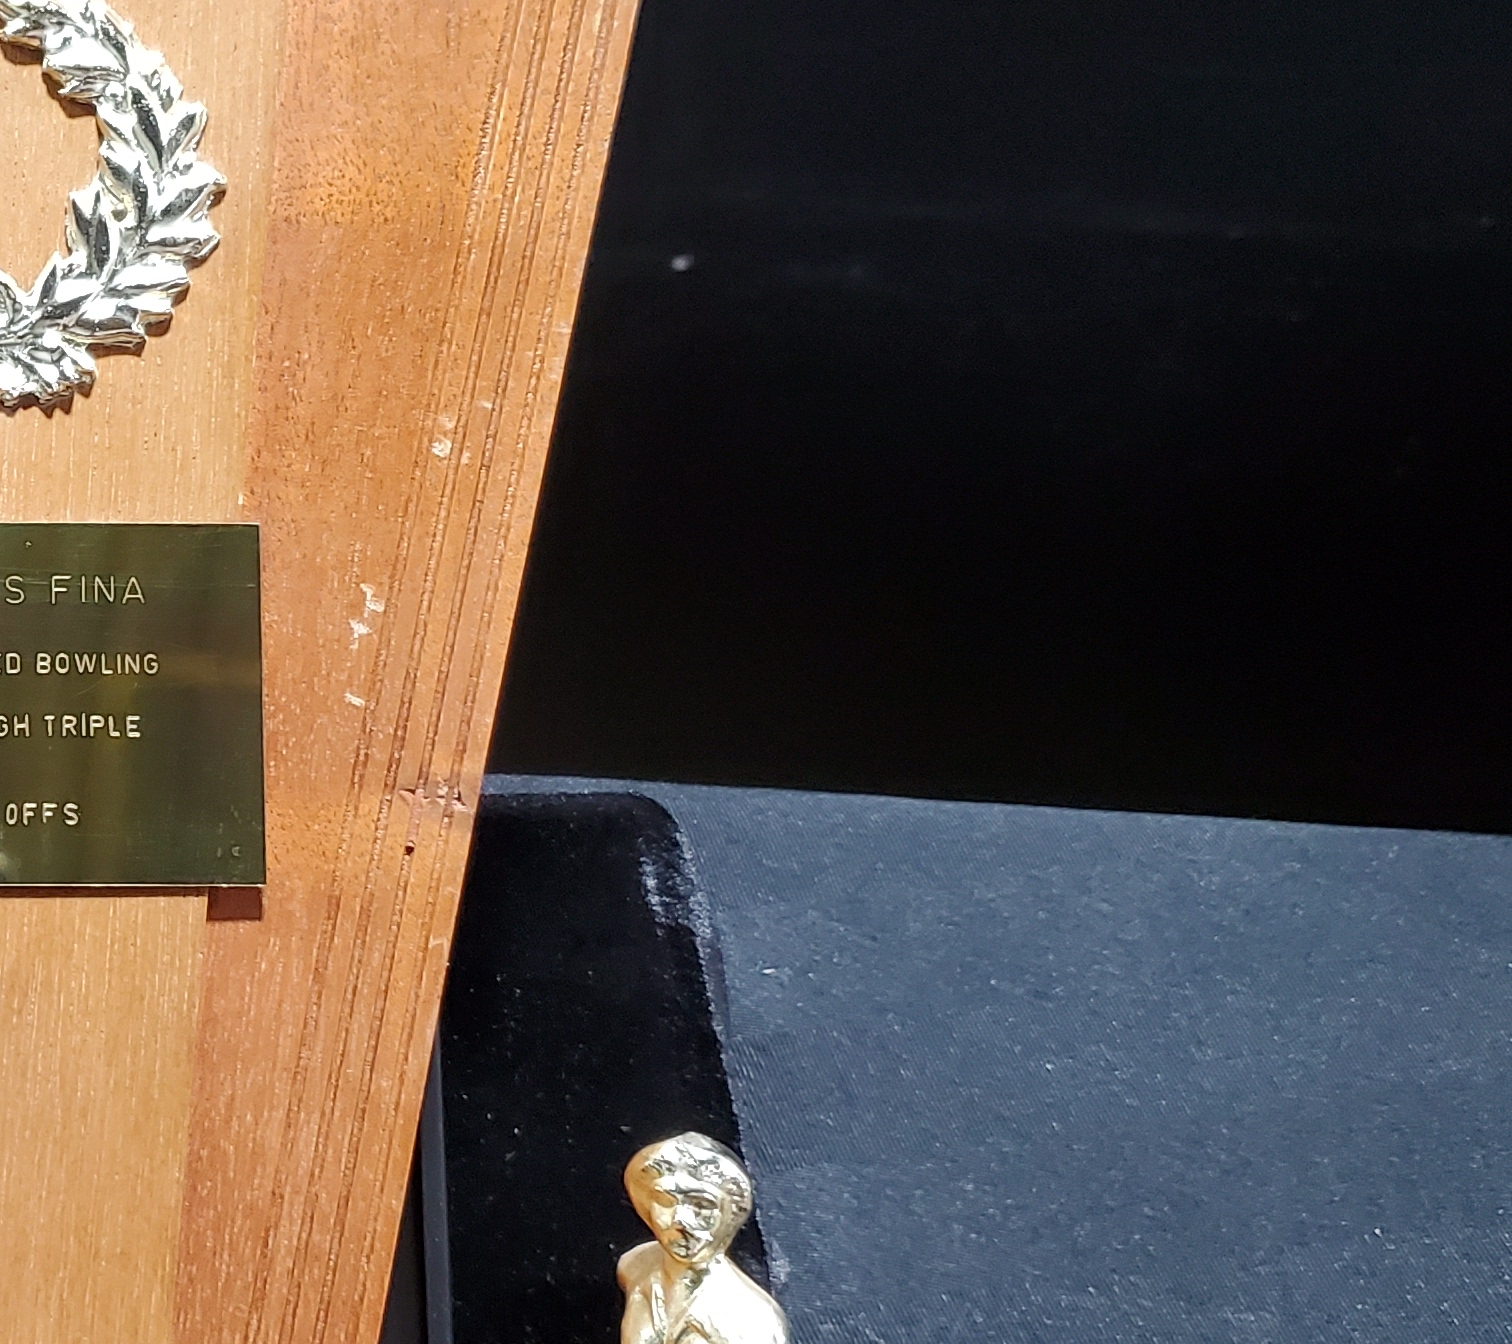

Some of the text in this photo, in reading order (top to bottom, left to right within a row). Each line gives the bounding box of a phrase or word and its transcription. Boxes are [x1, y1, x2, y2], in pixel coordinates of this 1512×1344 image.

[50, 575, 146, 604] FINA
[35, 653, 160, 675] BOWLING
[44, 713, 142, 738] TRIPLE
[5, 803, 81, 825] OFFS
